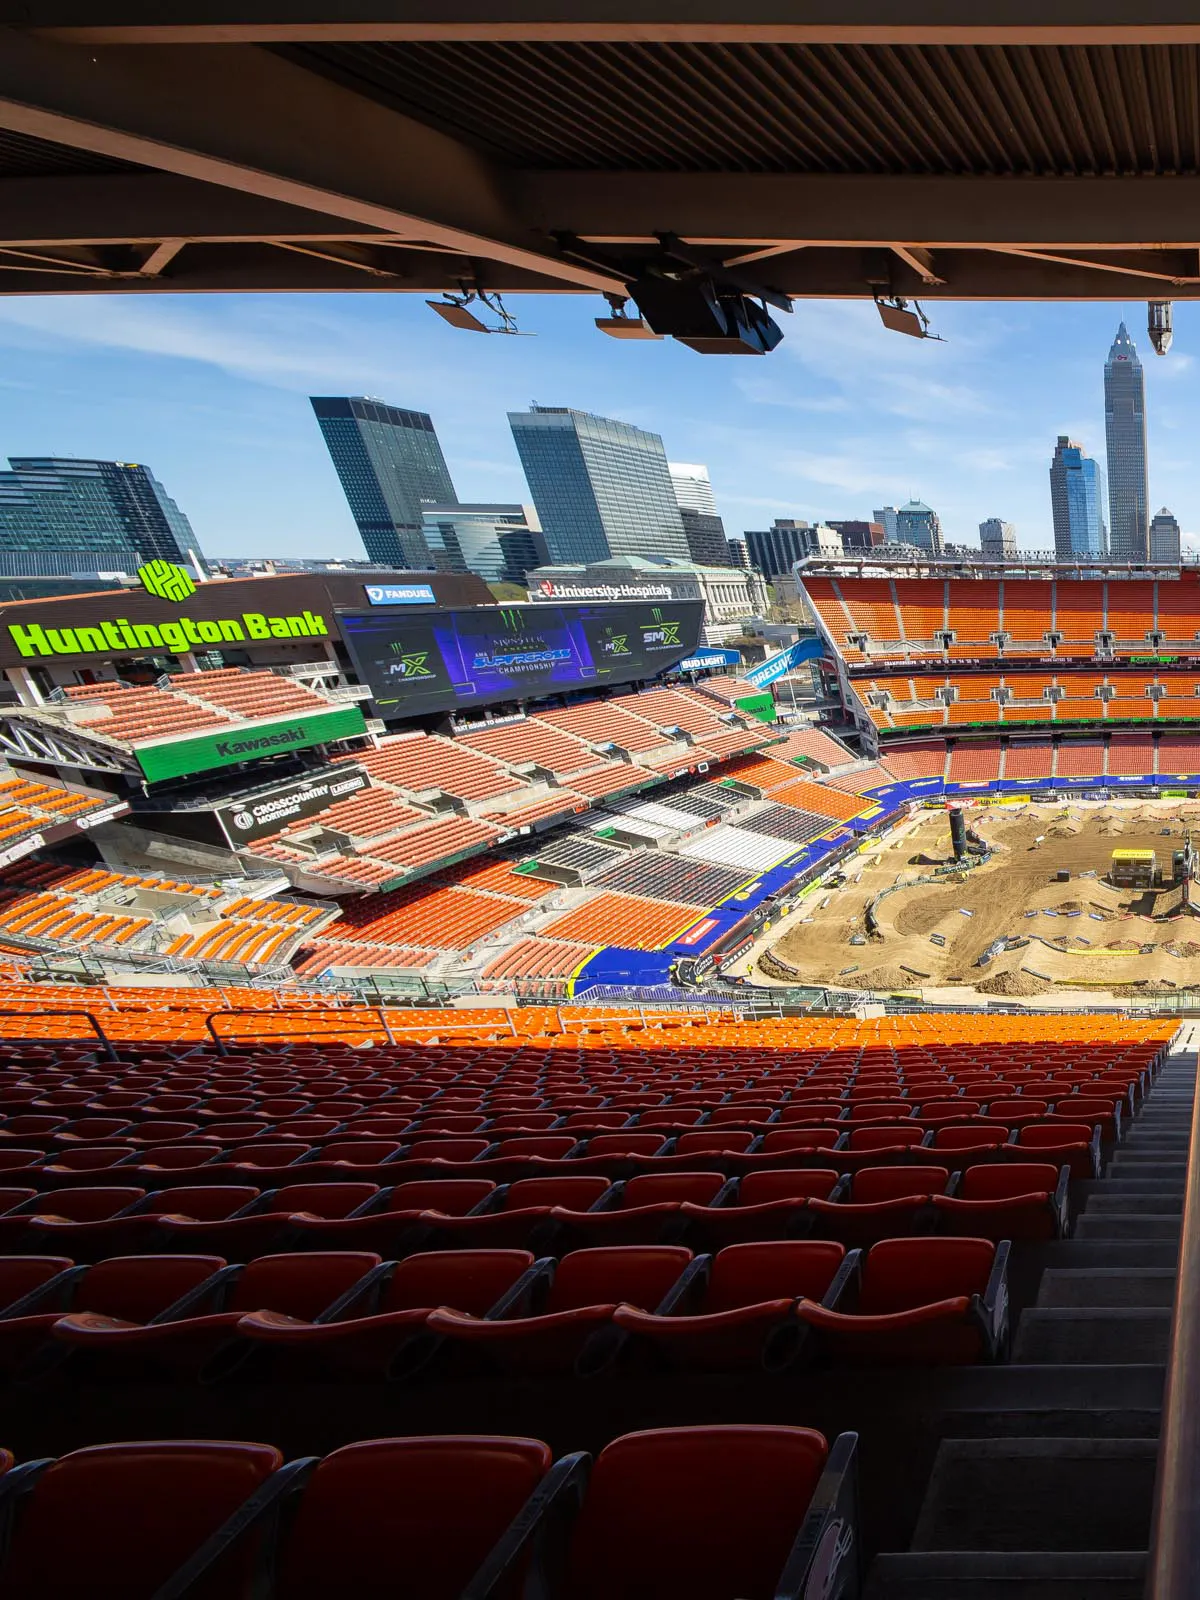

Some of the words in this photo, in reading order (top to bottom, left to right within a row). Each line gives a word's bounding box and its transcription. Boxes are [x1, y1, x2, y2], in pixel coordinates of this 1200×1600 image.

[385, 589, 433, 599] FANDUEL
[553, 584, 619, 599] University
[621, 584, 672, 598] Hospitals
[8, 617, 246, 657] Huntington
[242, 611, 329, 640] Bank
[643, 627, 681, 645] SMX
[498, 661, 555, 674] CHAMPIONSHIP
[681, 659, 701, 669] BUD
[702, 656, 725, 666] LIGHT
[215, 727, 306, 757] Kawasaki
[253, 785, 329, 817] CROSSCOUNTRY
[332, 779, 362, 794] LANDING
[256, 804, 301, 825] MORTGAGE
